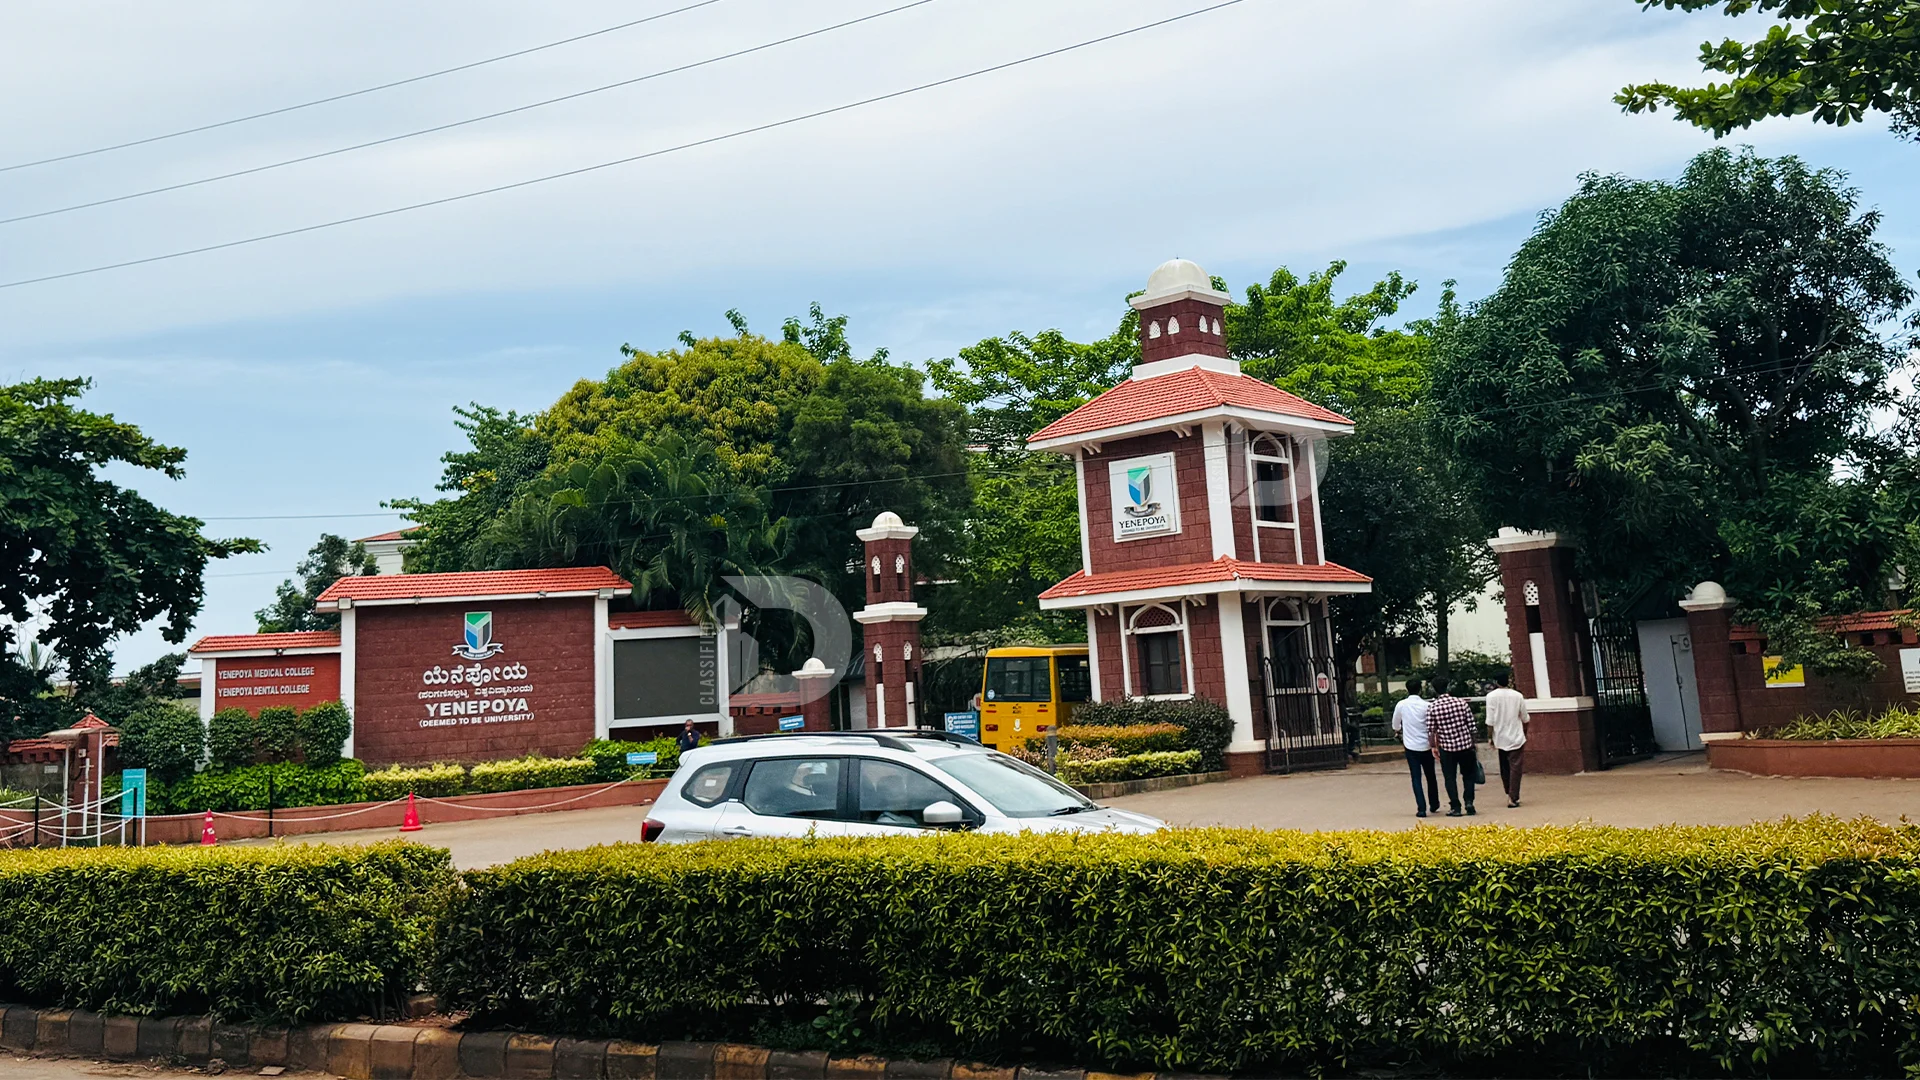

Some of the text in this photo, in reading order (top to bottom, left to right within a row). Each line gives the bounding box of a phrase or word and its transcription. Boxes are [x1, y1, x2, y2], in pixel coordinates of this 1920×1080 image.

[1119, 516, 1166, 529] YENEPOYA
[218, 666, 315, 679] YENEPOYA MEDICAL COLLEGE
[218, 684, 310, 697] YENEPOYA DENTAL COLLEGE
[425, 698, 529, 717] YENEPOYA
[419, 718, 457, 728] (DEEMED
[484, 712, 535, 723] UNIVERSITY)
